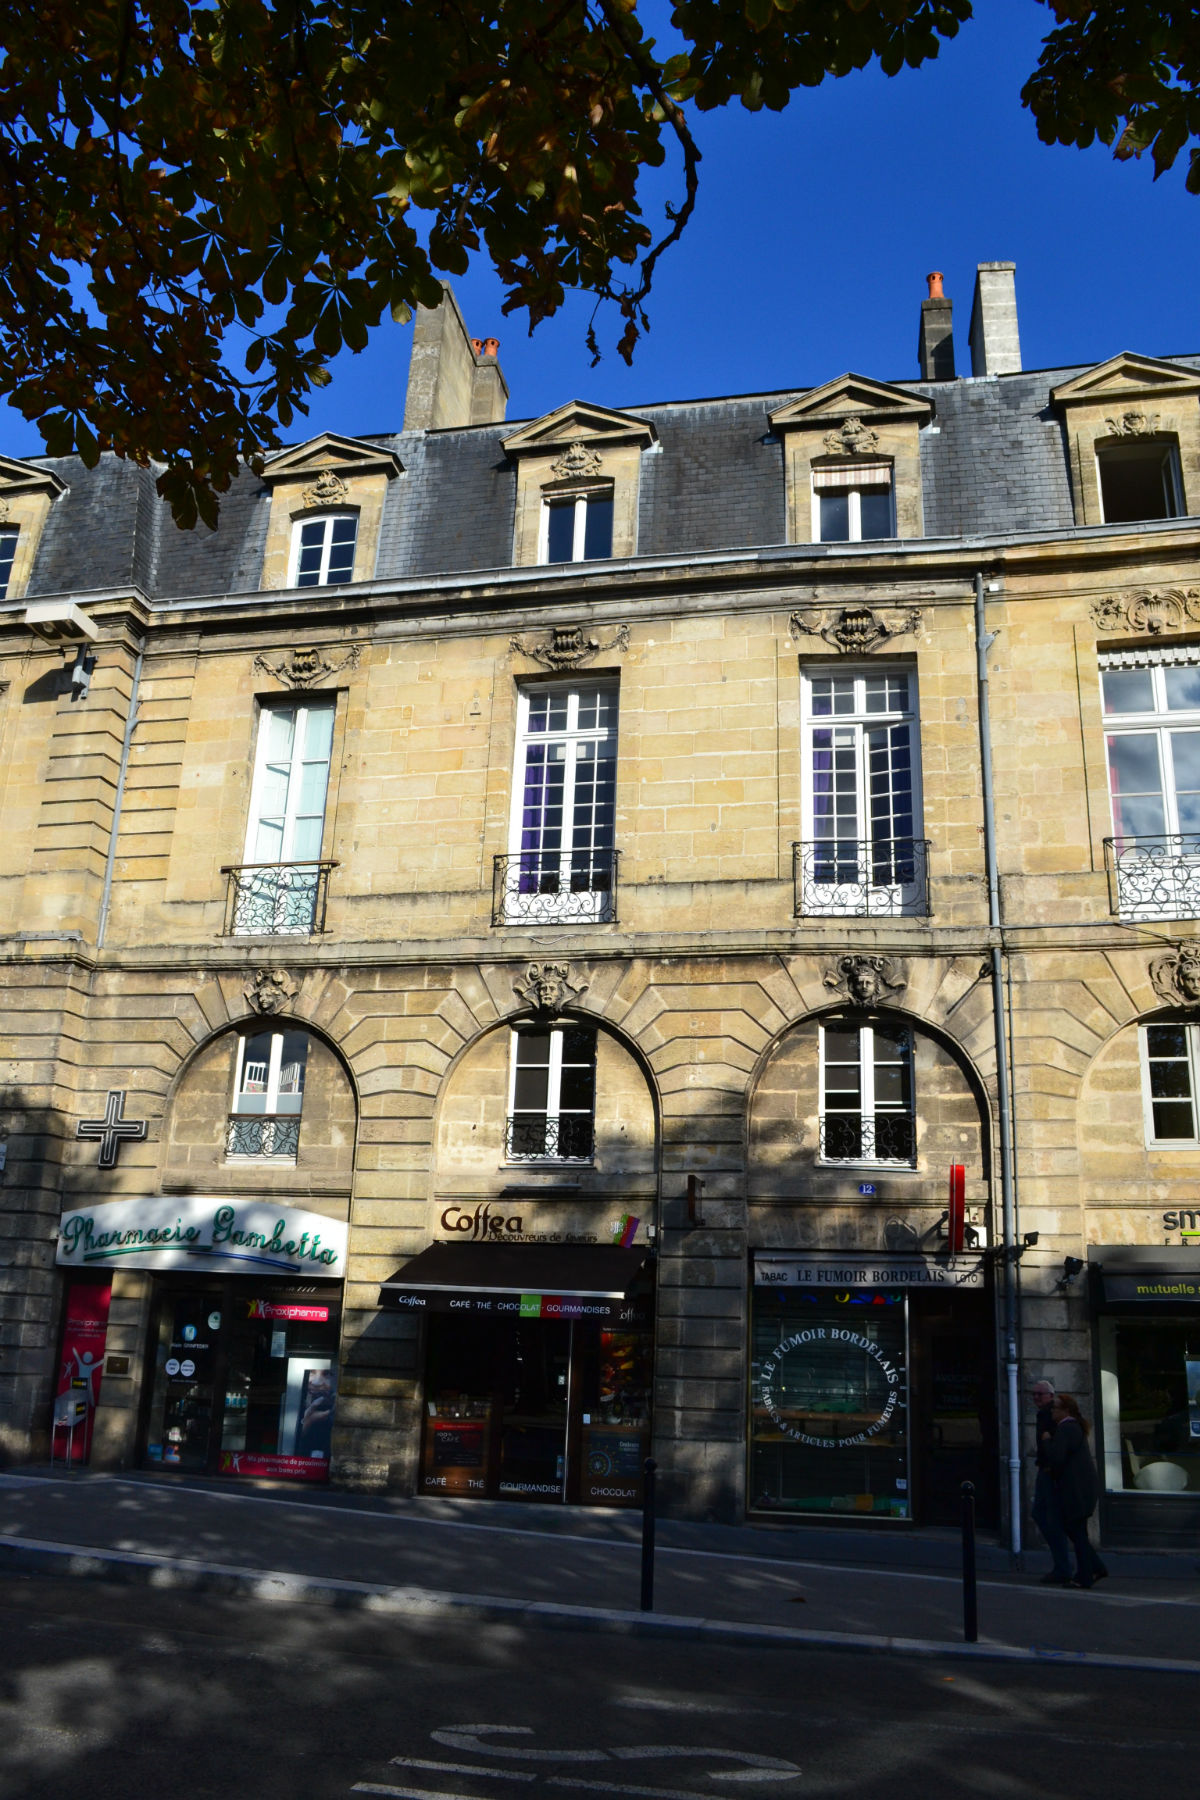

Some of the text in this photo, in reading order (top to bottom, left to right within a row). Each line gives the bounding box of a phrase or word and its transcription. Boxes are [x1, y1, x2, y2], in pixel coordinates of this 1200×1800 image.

[863, 1184, 873, 1194] 12
[440, 1203, 523, 1241] Coffea
[63, 1205, 338, 1265] Pharmacie Gambetta
[488, 1231, 547, 1242] Découvreurs
[550, 1232, 561, 1242] de
[761, 1272, 788, 1282] TABAC
[797, 1270, 945, 1283] LE FUMOIR BORDELAIS
[955, 1273, 978, 1283] LOTO
[1137, 1283, 1195, 1295] mutuelle
[398, 1295, 426, 1308] Coffea
[450, 1298, 611, 1315] CAFÉ THÉ CHOCOLAT GOURMANDISES
[264, 1304, 327, 1319] Proxipharma
[761, 1327, 899, 1384] LE FUMOIR BORDELAIS
[786, 1428, 835, 1448] ARTICLES
[839, 1432, 867, 1448] POUR
[867, 1391, 898, 1436] FUMEURS
[425, 1476, 447, 1487] CAFÉ
[468, 1479, 485, 1489] THÉ
[499, 1481, 561, 1495] GOURMANDISE
[590, 1486, 638, 1497] CHOCOLAT
